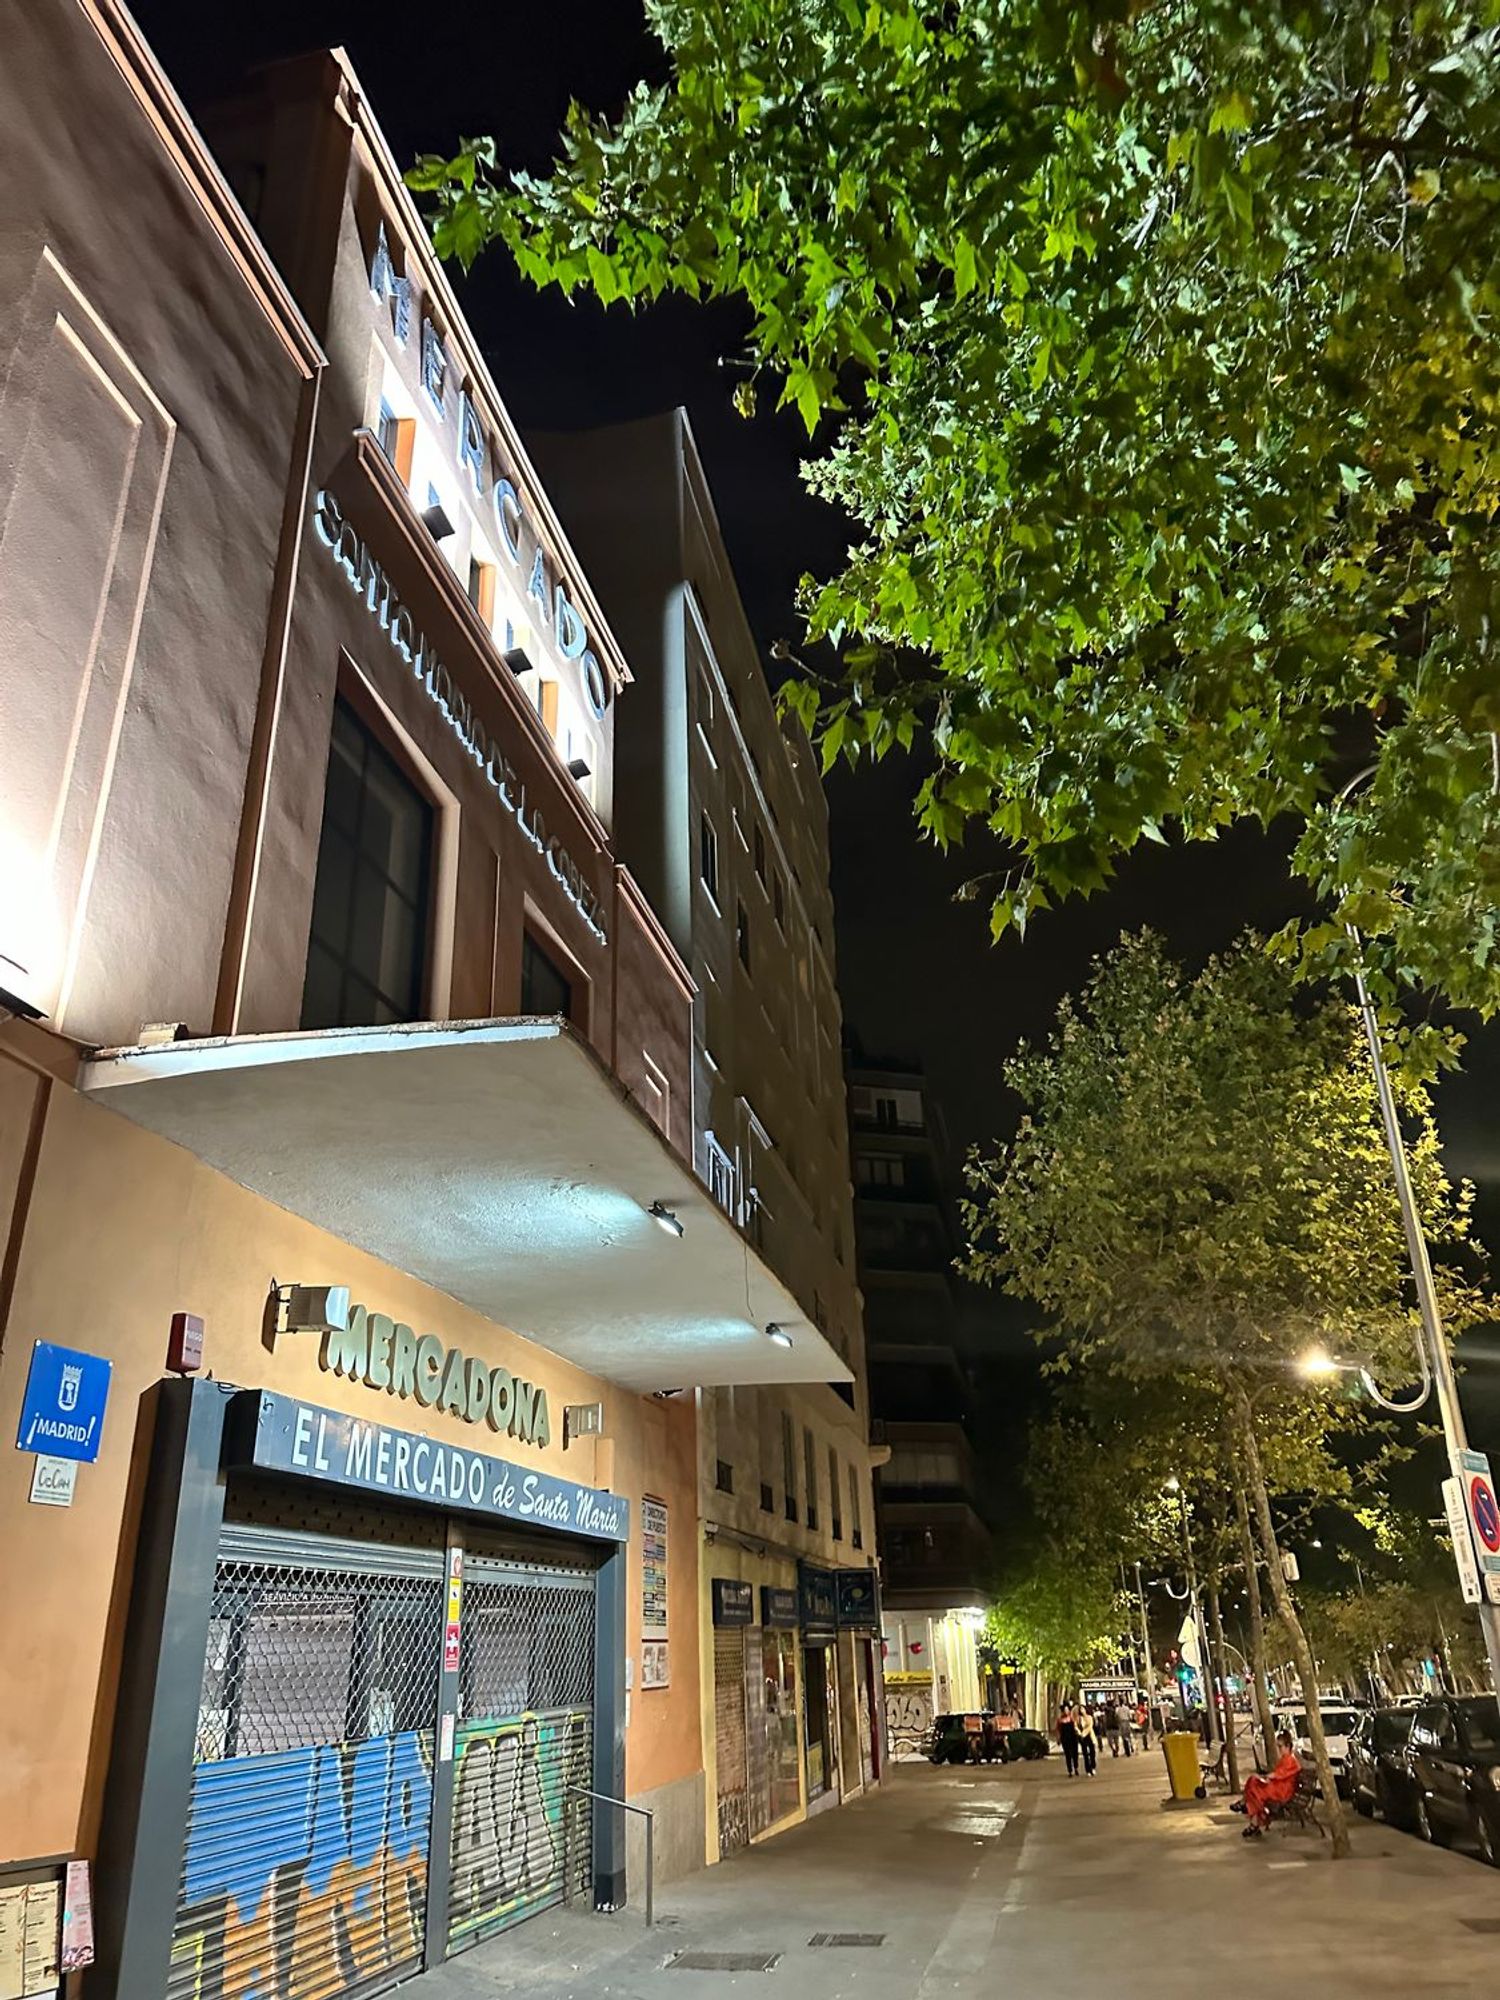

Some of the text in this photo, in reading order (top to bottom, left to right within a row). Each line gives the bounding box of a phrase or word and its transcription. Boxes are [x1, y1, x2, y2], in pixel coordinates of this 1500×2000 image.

[370, 218, 607, 722] MERCADO
[487, 736, 518, 813] DE
[318, 1303, 552, 1450] MERCADONA
[291, 1406, 330, 1472] EL
[344, 1424, 486, 1505] MERCADO
[492, 1471, 515, 1510] de
[518, 1475, 571, 1525] Santa
